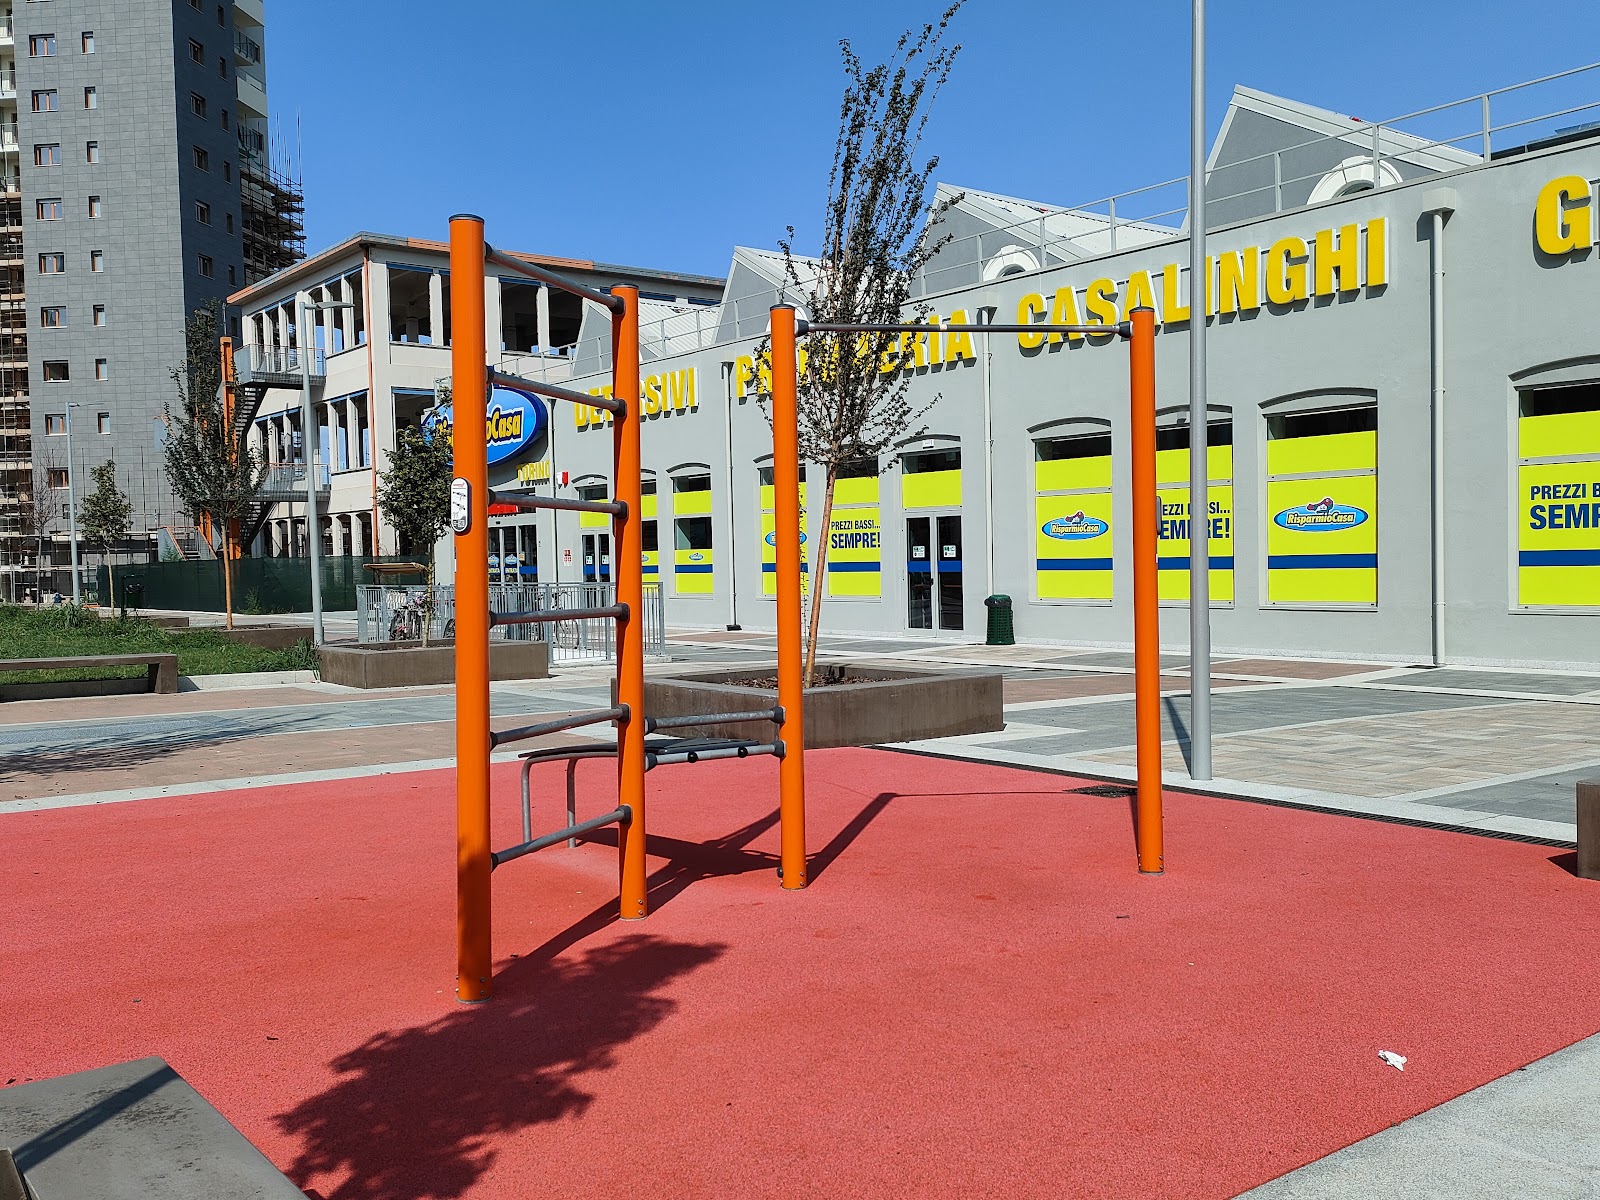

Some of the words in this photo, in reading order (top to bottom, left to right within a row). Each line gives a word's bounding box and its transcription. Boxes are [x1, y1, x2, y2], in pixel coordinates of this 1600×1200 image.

[735, 309, 976, 398] PRERIA
[574, 367, 698, 427] DETSIVI
[1530, 483, 1587, 501] PREZZI
[1162, 503, 1184, 516] EZZI
[831, 520, 853, 531] PREZZI
[1286, 511, 1355, 526] RisparmioCasa
[1050, 522, 1100, 535] RisparmioCasa
[1160, 517, 1230, 540] EME!
[831, 532, 881, 549] SEMPRE!
